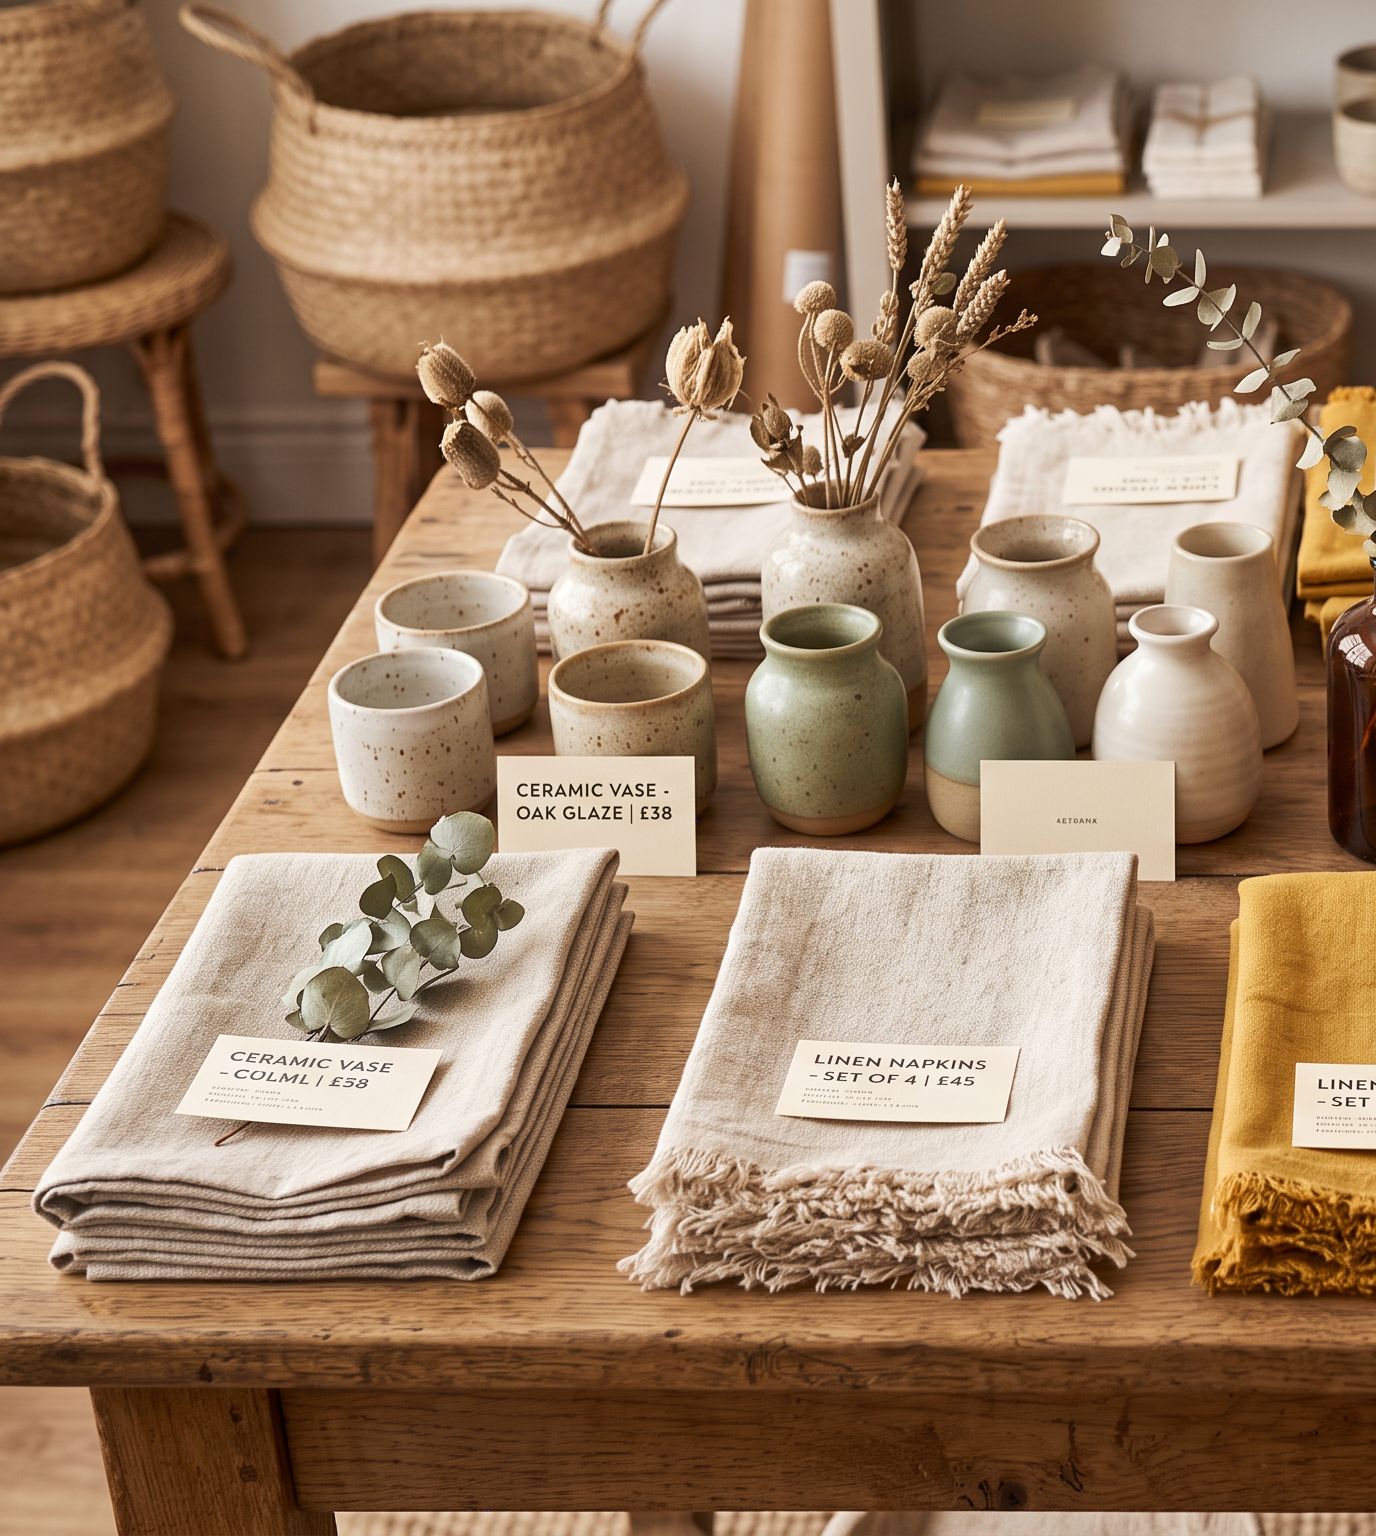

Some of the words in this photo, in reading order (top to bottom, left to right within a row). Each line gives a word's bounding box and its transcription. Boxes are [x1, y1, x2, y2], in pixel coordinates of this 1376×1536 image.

[516, 782, 603, 798] CERAMIC
[609, 782, 657, 798] VASE
[516, 805, 557, 821] OAK
[562, 805, 623, 821] GLAZE
[640, 805, 673, 821] £38
[230, 1051, 333, 1070] CERAMIC
[340, 1059, 394, 1074] VASE
[814, 1054, 882, 1068] LINEN
[889, 1058, 987, 1071] NAPKINS
[233, 1069, 309, 1086] COLML
[328, 1076, 369, 1090] £58
[823, 1071, 863, 1083] SET
[868, 1073, 900, 1084] OF
[904, 1075, 917, 1086] 4
[936, 1075, 975, 1087] £45
[1331, 1096, 1371, 1108] SET
